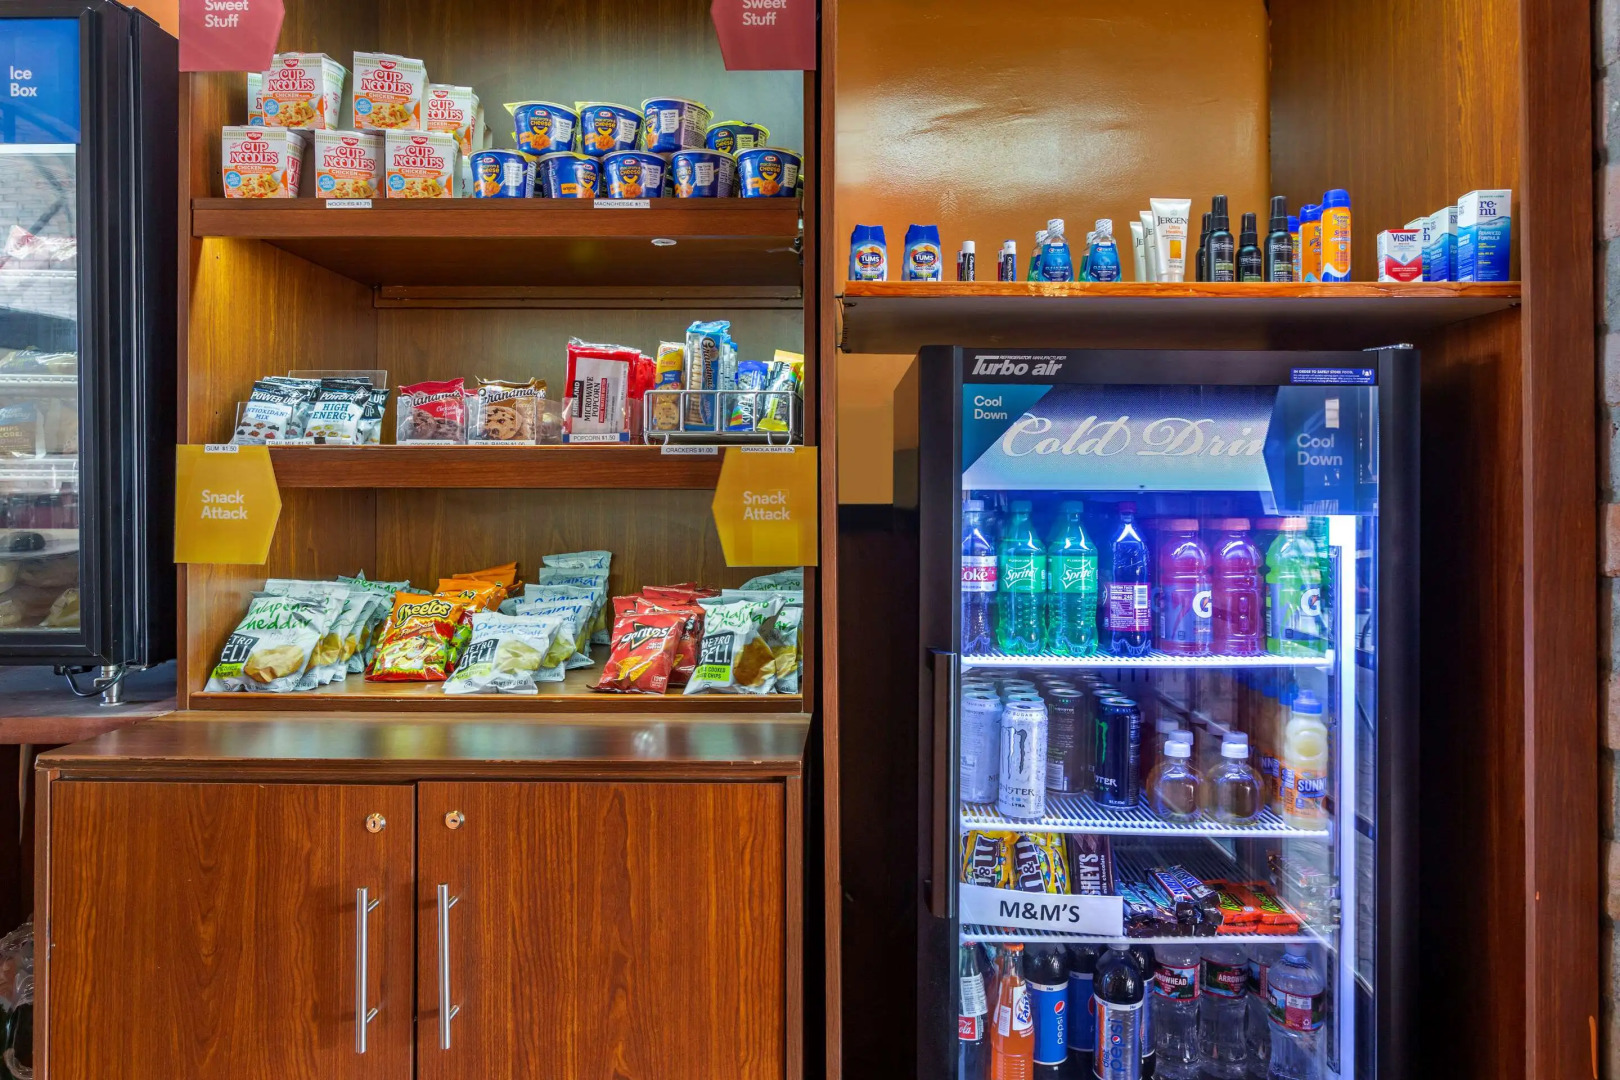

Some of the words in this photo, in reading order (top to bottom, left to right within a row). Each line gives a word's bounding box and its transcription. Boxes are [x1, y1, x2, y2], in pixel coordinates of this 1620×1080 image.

[205, 0, 249, 11] Sweet
[742, 0, 787, 9] Sweet
[205, 14, 239, 27] Stuff
[742, 12, 777, 25] Stuff
[10, 66, 32, 80] Ice
[279, 69, 305, 80] CUP
[373, 69, 403, 82] CUP
[10, 83, 38, 97] Box
[268, 79, 315, 91] NOODLES
[361, 79, 413, 95] NOODLES
[428, 99, 454, 110] CUP
[427, 109, 464, 121] OODLES
[241, 142, 269, 152] CUP
[335, 146, 365, 157] CUP
[405, 146, 434, 157] CUP
[230, 152, 278, 164] NOODLES
[323, 155, 375, 171] NOODLES
[394, 154, 444, 169] NOODLES
[1479, 208, 1497, 216] nu
[1157, 216, 1188, 227] JERGEN
[1391, 234, 1417, 242] VISINE
[971, 355, 1029, 376] Turbo
[1031, 360, 1063, 376] air
[250, 391, 284, 404] POWER
[374, 394, 386, 404] UP
[584, 376, 594, 422] MICROWAVE
[592, 382, 600, 418] POPCORN
[974, 396, 1002, 407] Cool
[246, 406, 289, 418] NTIOXIDANT
[322, 403, 349, 412] HIGH
[364, 406, 375, 417] UP
[312, 411, 355, 422] ENERGY
[974, 409, 1008, 420] Down
[1001, 412, 1132, 457] Cold
[1296, 433, 1335, 449] Cool
[1297, 451, 1343, 466] Down
[201, 489, 244, 503] Snack
[743, 490, 787, 504] Snack
[200, 505, 248, 519] Attack
[743, 507, 790, 520] Attack
[1006, 568, 1034, 581] Sprite
[1062, 568, 1092, 581] Sprite
[1192, 590, 1213, 618] G
[1300, 589, 1321, 616] G
[394, 599, 453, 628] Cheetos
[233, 614, 312, 631] heddar
[474, 622, 547, 634] Original
[226, 635, 254, 645] ETRO
[621, 626, 671, 643] Doritos
[701, 635, 731, 650] METRO
[221, 645, 248, 663] ELI
[699, 645, 731, 664] DELI
[1101, 883, 1109, 895] milk
[999, 900, 1081, 923] M&M'S
[1108, 1018, 1126, 1073] pepsi
